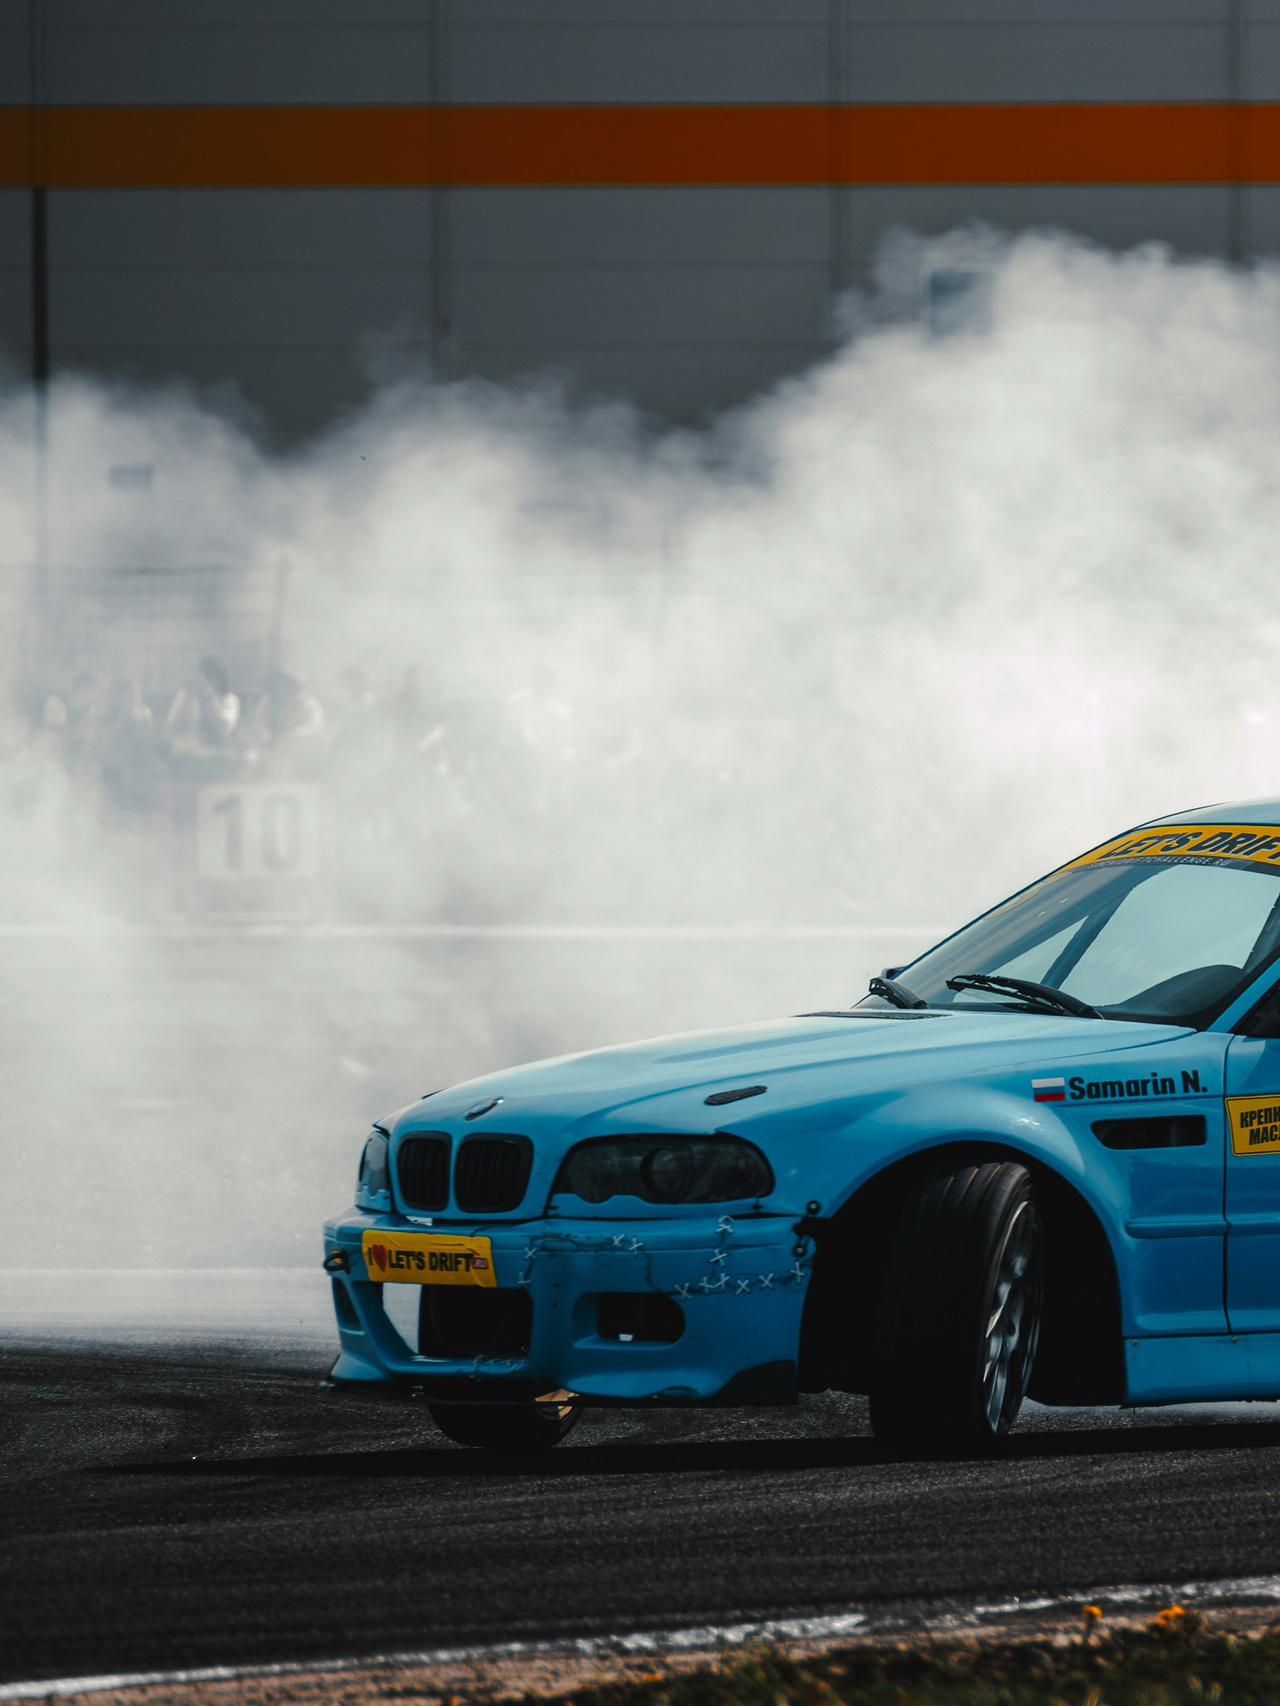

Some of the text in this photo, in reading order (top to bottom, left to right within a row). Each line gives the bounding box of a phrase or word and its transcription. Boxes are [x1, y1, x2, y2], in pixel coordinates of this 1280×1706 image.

[213, 795, 302, 873] 10
[1097, 831, 1203, 861] LET'S
[1069, 1070, 1208, 1100] Samarin N.
[388, 1250, 426, 1271] LET'S
